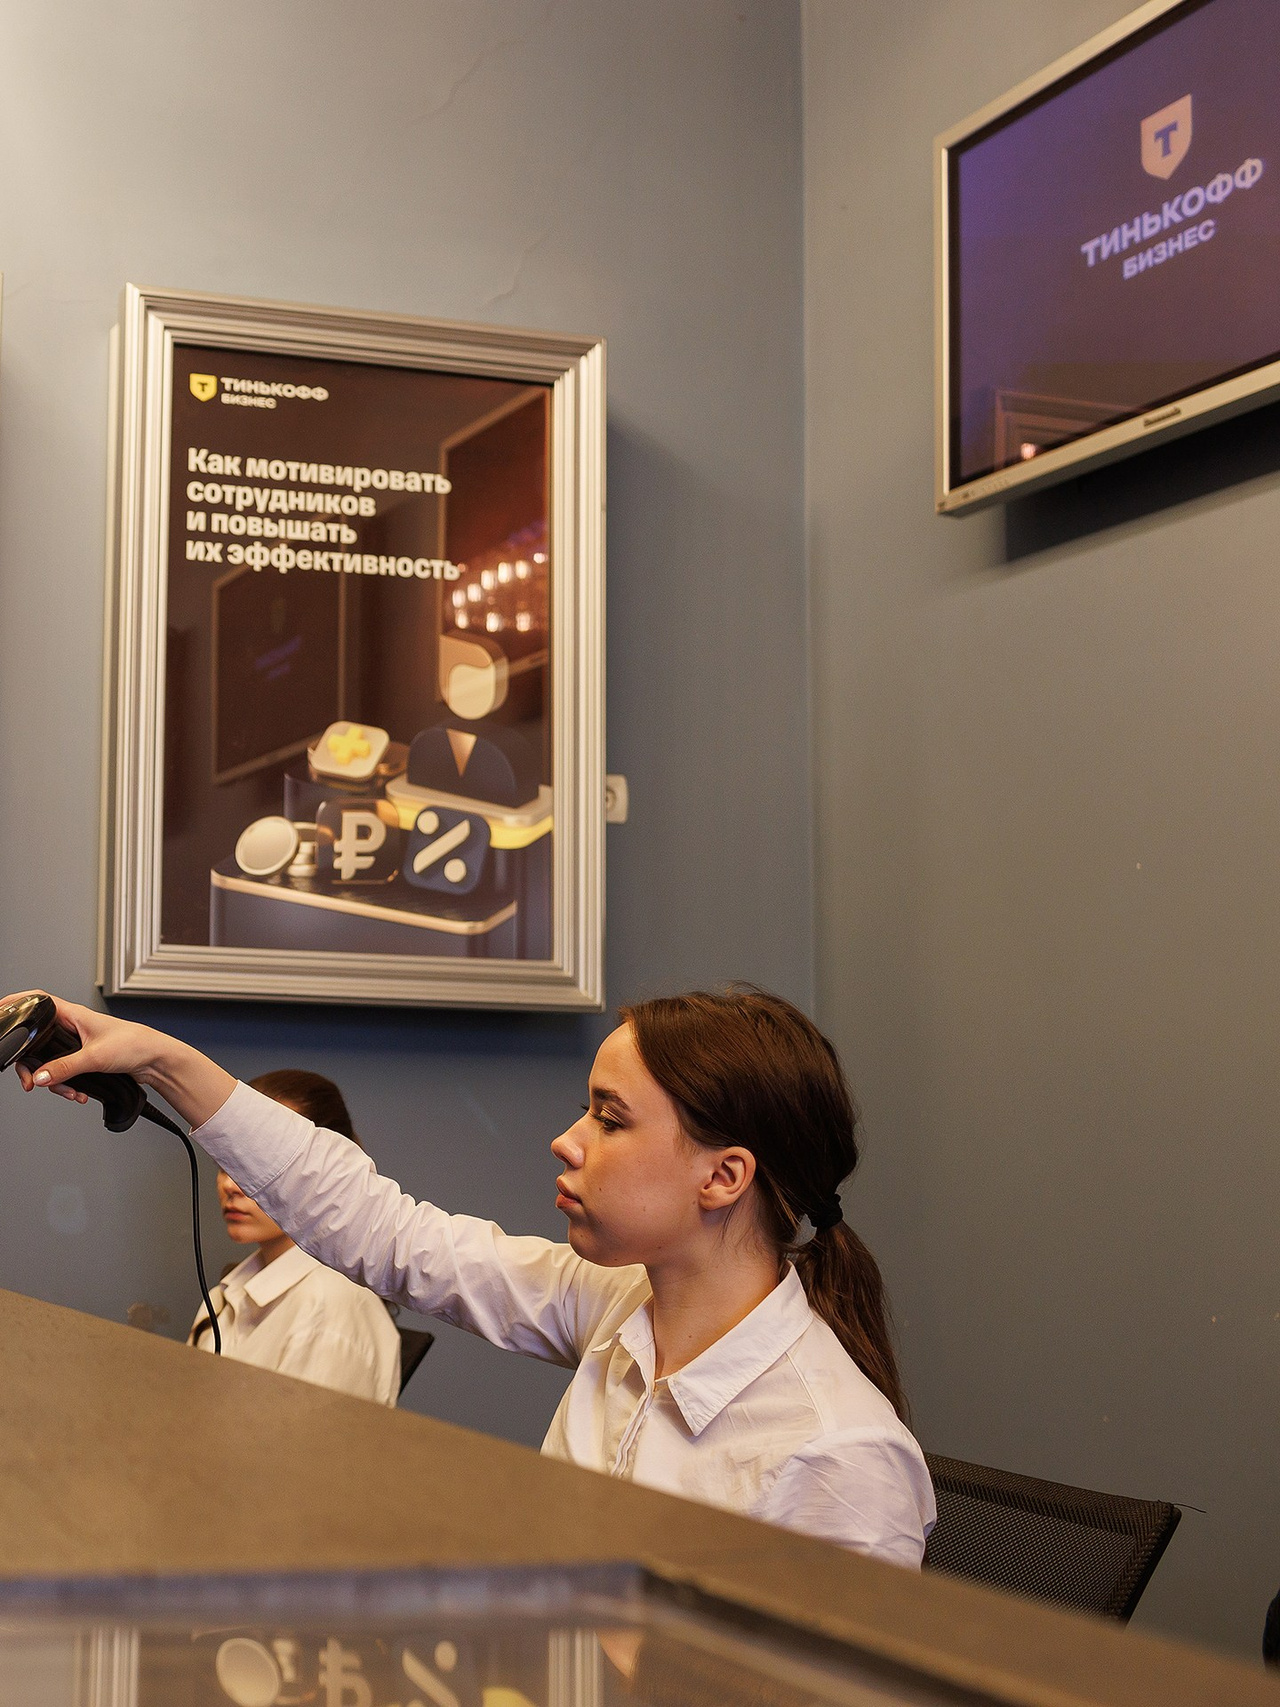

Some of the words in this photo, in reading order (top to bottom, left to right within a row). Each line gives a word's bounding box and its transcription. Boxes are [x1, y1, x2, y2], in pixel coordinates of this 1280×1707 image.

[1080, 157, 1265, 268] ТИНЬКОФФ
[1122, 218, 1217, 281] БИЗНЕС
[220, 376, 330, 402] ТИНЬКОФФ
[220, 392, 277, 410] БИЗНЕС
[187, 447, 242, 476] Как
[245, 456, 453, 495] мотивировать
[185, 480, 377, 517] сотрудников
[186, 510, 207, 533] и
[210, 512, 358, 545] повышать
[185, 540, 223, 565] их
[226, 541, 461, 582] эффективность
